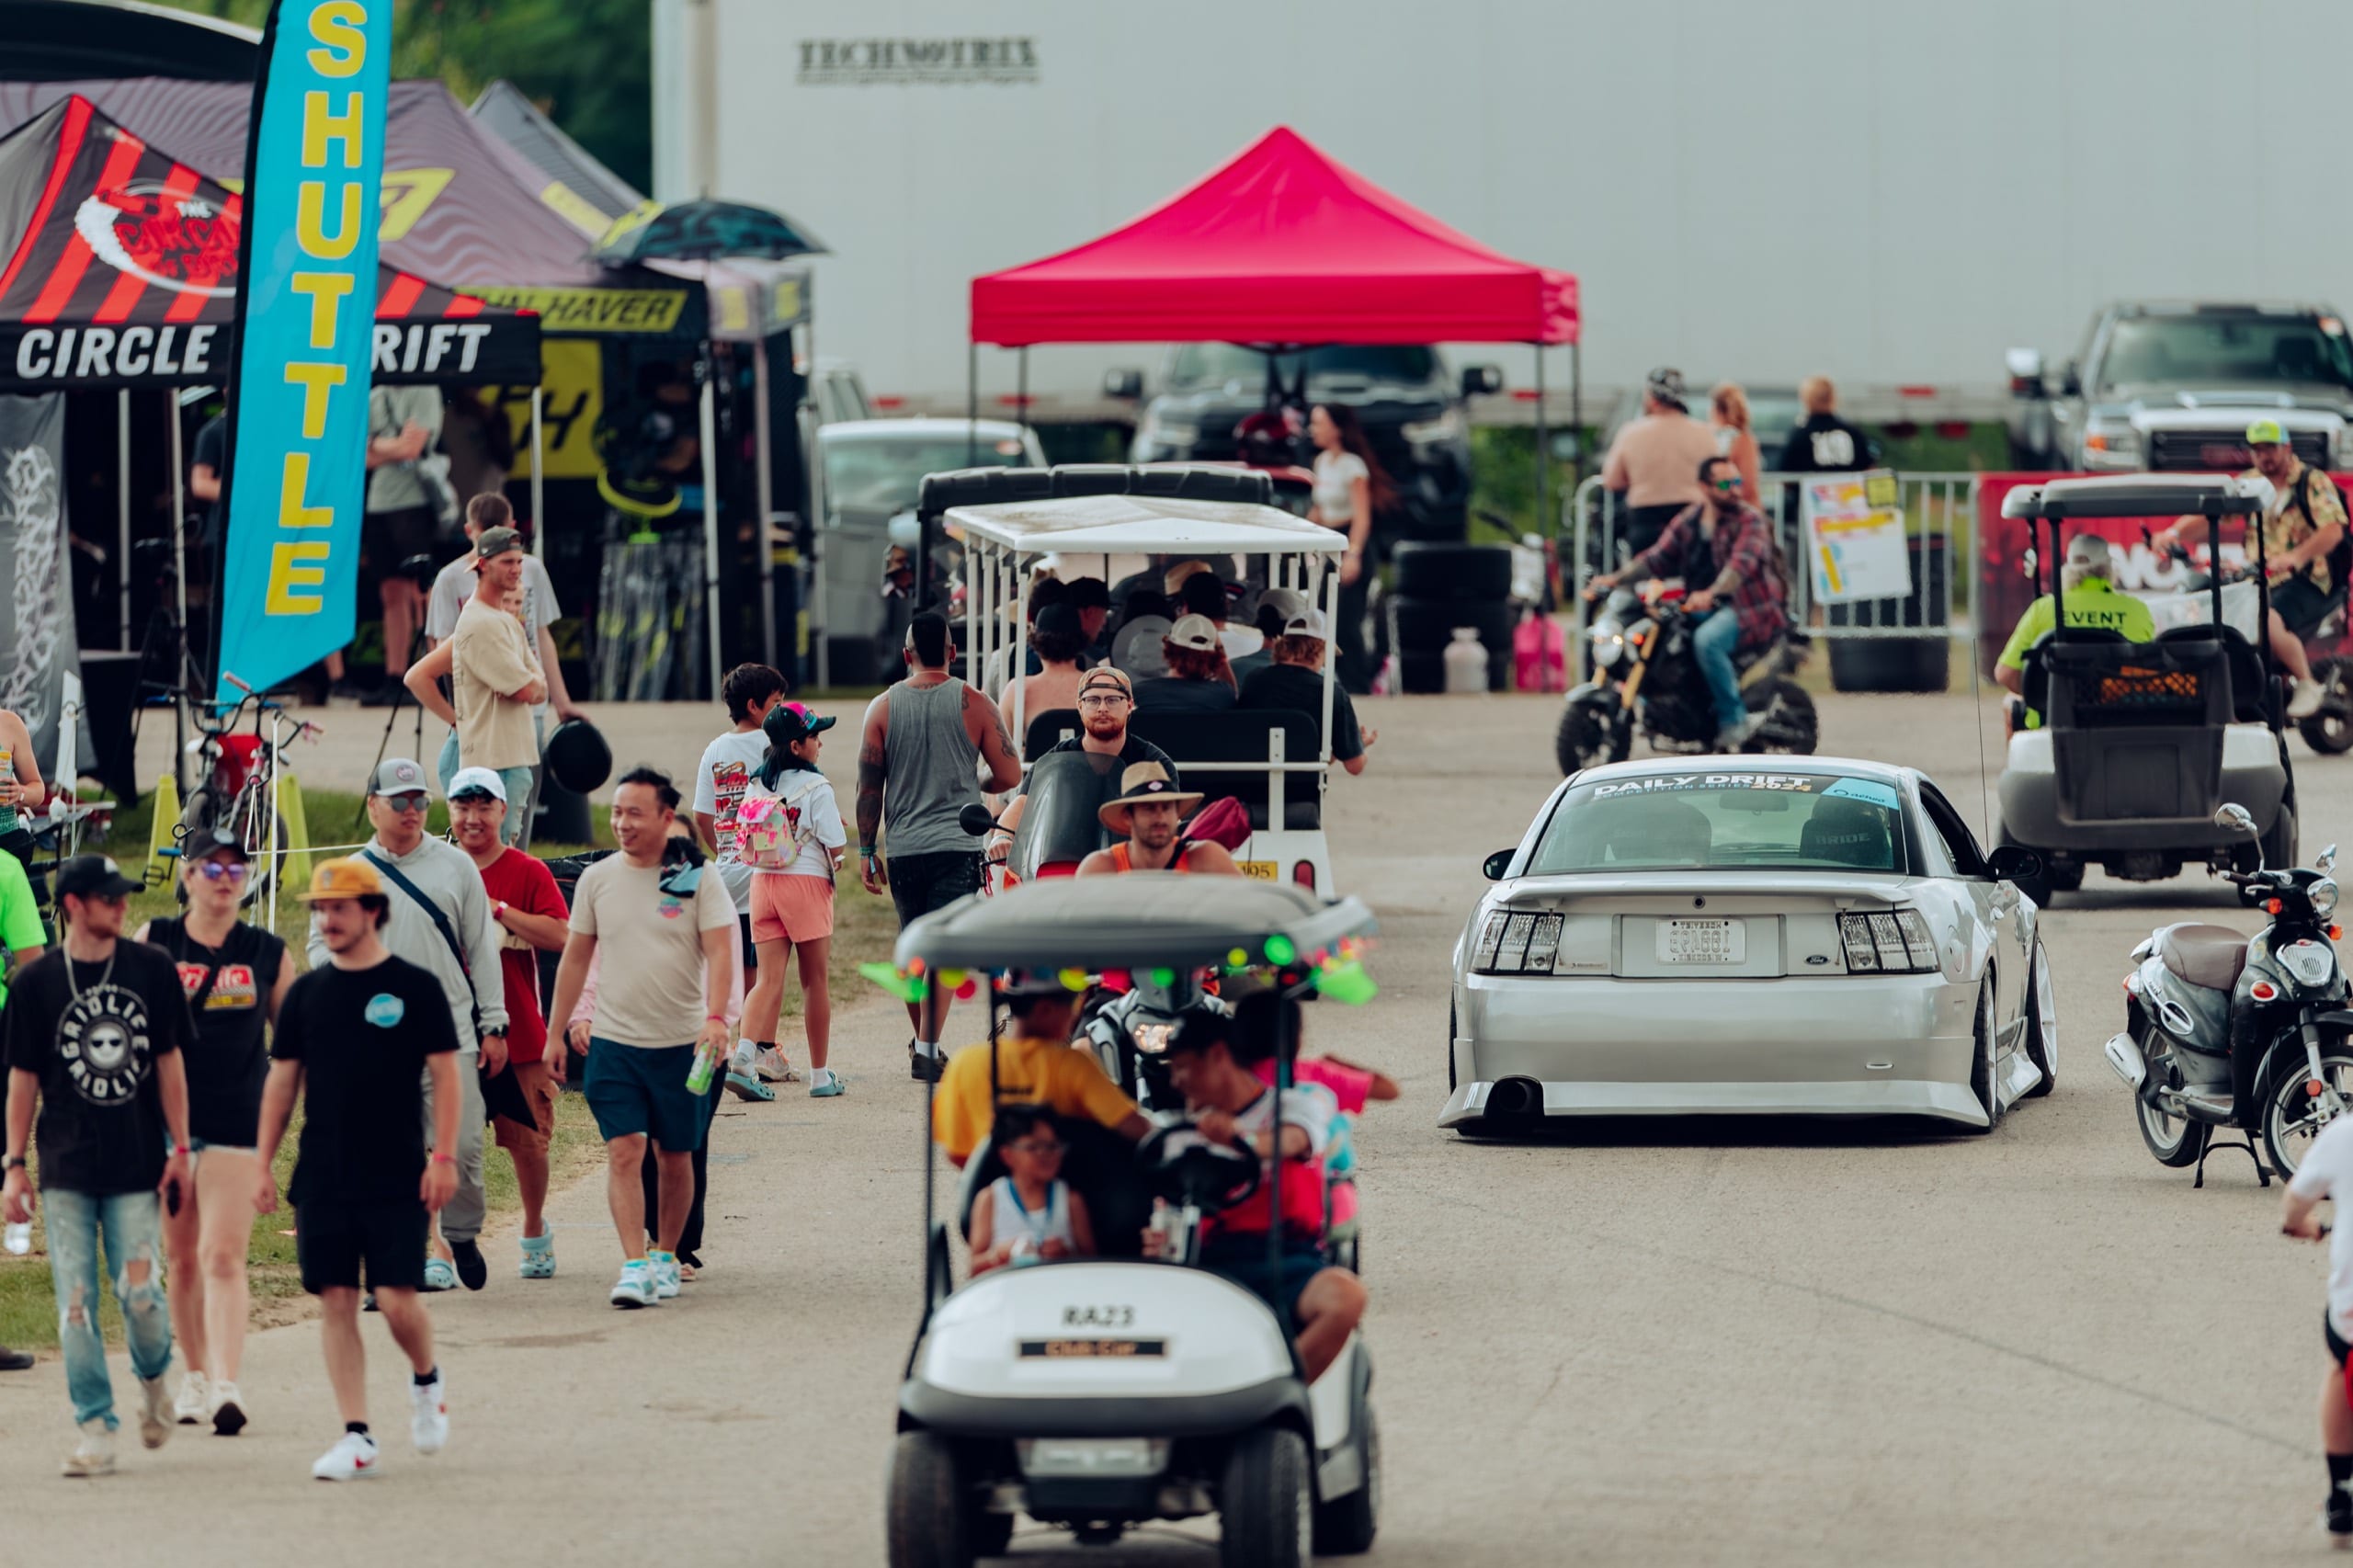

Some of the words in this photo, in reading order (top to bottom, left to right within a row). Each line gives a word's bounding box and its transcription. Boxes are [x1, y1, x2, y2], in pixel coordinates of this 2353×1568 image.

[265, 0, 367, 615] SHUTTLE
[546, 293, 676, 324] HAVER
[17, 324, 217, 380] CIRCLE
[371, 324, 492, 372] RIFT
[1594, 776, 1699, 799] DAILY
[1705, 775, 1811, 788] DRIFT
[1815, 833, 1870, 845] BRIDE
[1063, 1305, 1135, 1326] RA23
